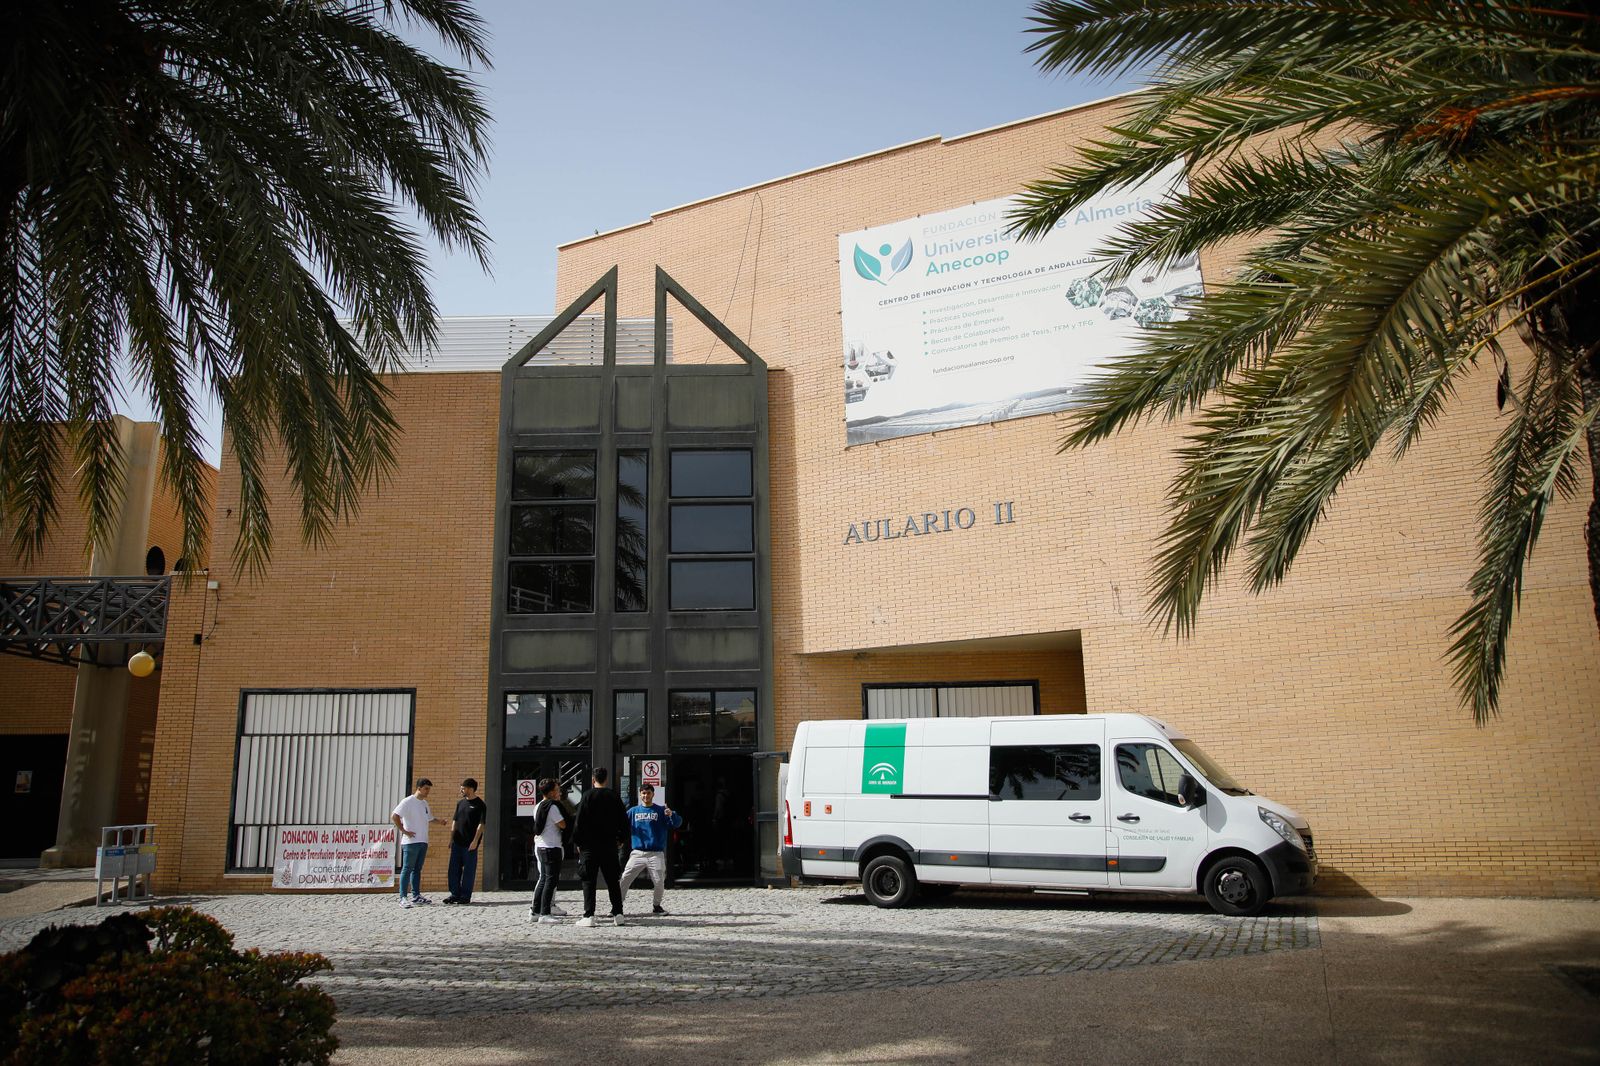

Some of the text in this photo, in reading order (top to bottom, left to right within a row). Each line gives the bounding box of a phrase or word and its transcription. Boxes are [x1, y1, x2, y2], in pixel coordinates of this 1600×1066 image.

[924, 226, 1024, 257] Universida
[1074, 197, 1153, 226] Almería
[925, 249, 1010, 277] Anecoop
[878, 295, 909, 306] CENTRO
[910, 292, 921, 301] DE
[1034, 266, 1046, 275] DE
[1048, 256, 1097, 271] ANDALUCÍA
[962, 307, 995, 319] Docentes
[962, 321, 972, 329] de
[973, 315, 1005, 328] Empresa
[930, 335, 952, 345] Becas
[952, 333, 962, 341] de
[931, 342, 978, 356] Convocatoria
[979, 339, 989, 347] de
[989, 331, 1019, 344] Premios
[1020, 331, 1030, 339] de
[1078, 319, 1094, 328] TFG
[843, 500, 1016, 545] AULARIO II
[634, 812, 659, 822] CHICAGO
[282, 829, 395, 846] DONACION de SANGRE y PLASMA
[283, 849, 299, 860] Centro
[300, 849, 307, 860] de
[298, 873, 365, 884] DONA SANGRE
